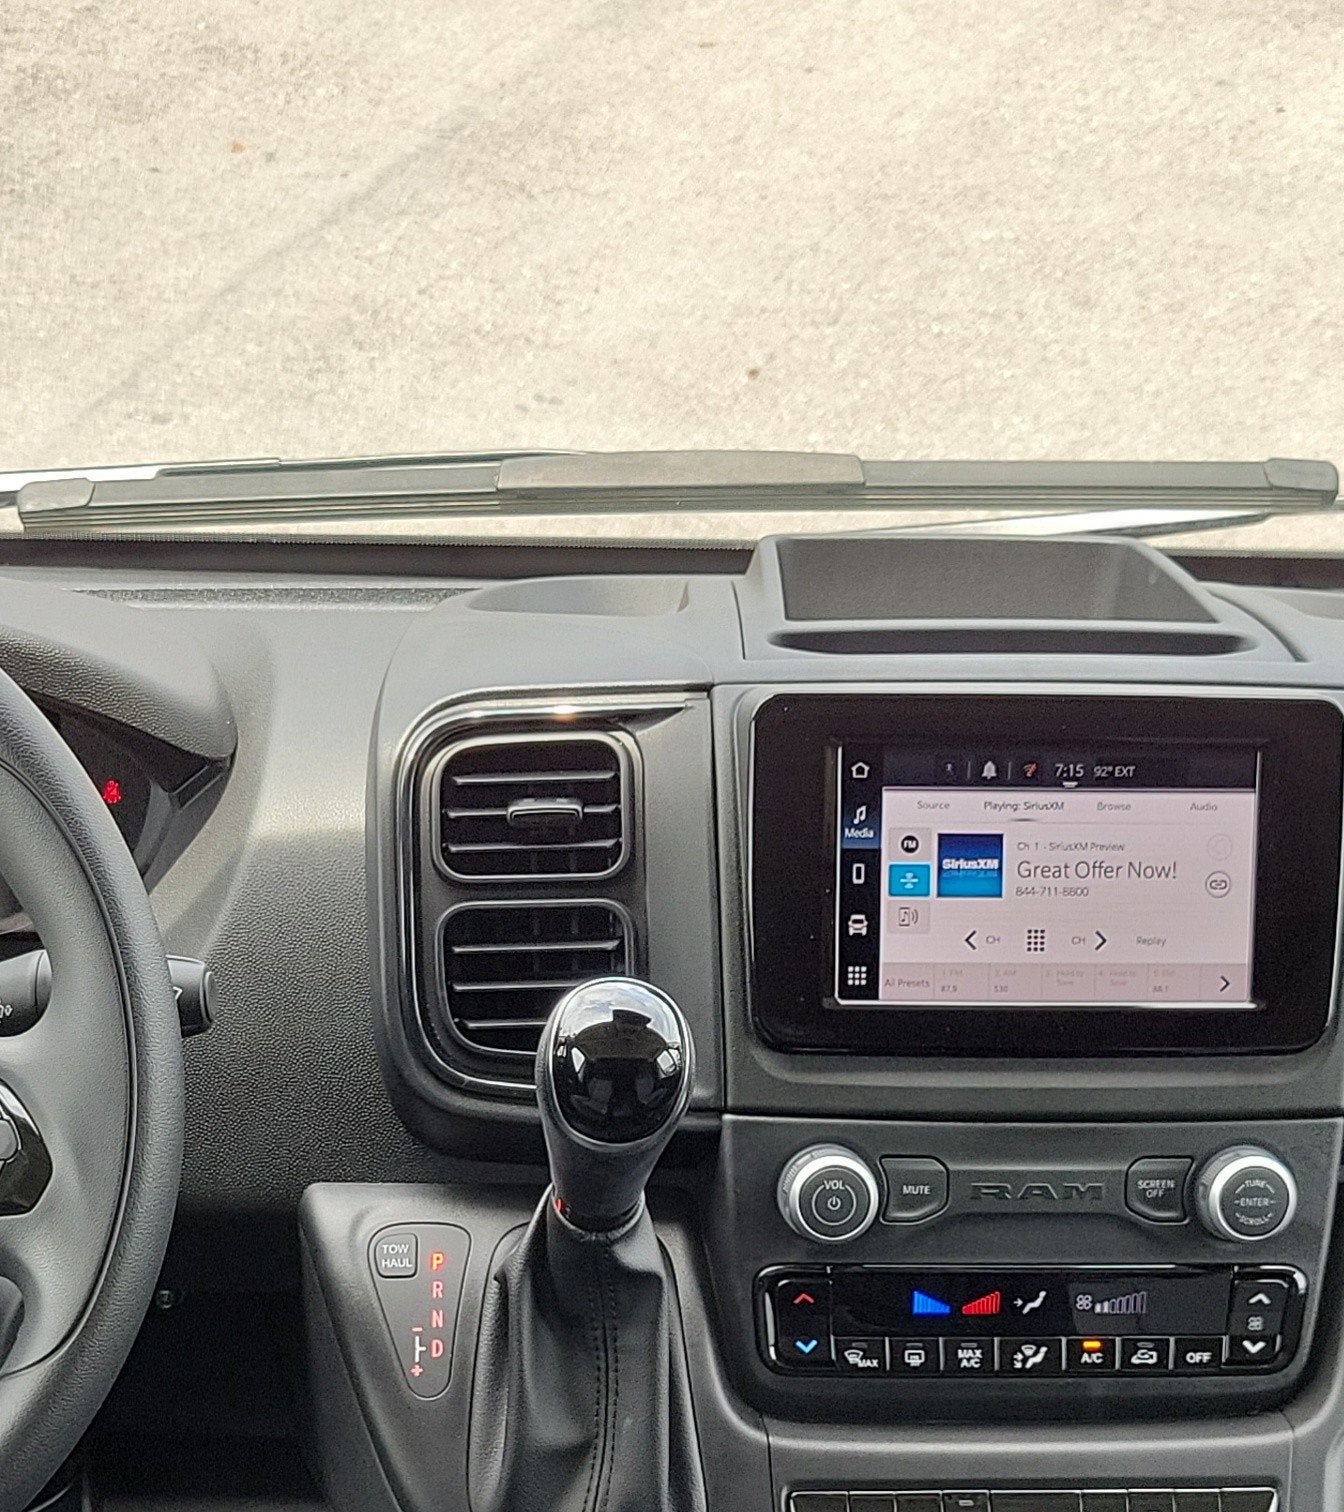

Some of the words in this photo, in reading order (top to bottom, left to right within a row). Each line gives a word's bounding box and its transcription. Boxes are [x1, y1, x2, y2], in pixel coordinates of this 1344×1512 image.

[1056, 763, 1085, 778] 7:15
[1114, 765, 1136, 778] EXT
[916, 801, 951, 811] Source
[983, 801, 1022, 813] Playing:
[1023, 801, 1065, 811] SiriusXM
[1096, 802, 1132, 812] Browse
[1189, 802, 1219, 812] Audio
[844, 828, 875, 839] Media
[1049, 842, 1088, 851] SiriusXM
[1089, 842, 1126, 851] Preview
[942, 858, 999, 870] SiriusXM
[1016, 861, 1070, 880] Great
[1074, 861, 1124, 880] Offer
[1127, 860, 1177, 880] Now!
[1136, 936, 1167, 947] Replay
[897, 978, 930, 988] Presets
[823, 1179, 845, 1190] VOL
[1136, 1179, 1176, 1190] SCREEN
[1244, 1179, 1267, 1189] TUNE
[902, 1185, 932, 1195] MUTE
[970, 1182, 1104, 1200] RAM
[1145, 1188, 1166, 1199] OFF
[1240, 1198, 1270, 1207] ENTER
[1238, 1214, 1269, 1226] SCROLL
[382, 1243, 409, 1255] TOW
[381, 1257, 413, 1269] HAUL
[431, 1253, 444, 1270] P
[432, 1281, 444, 1299] R
[431, 1309, 444, 1328] N
[431, 1339, 444, 1359] D
[957, 1350, 983, 1359] MAX
[858, 1359, 879, 1368] MAX
[1080, 1353, 1104, 1364] A/C
[1185, 1352, 1212, 1364] OFF
[960, 1359, 981, 1369] A/C
